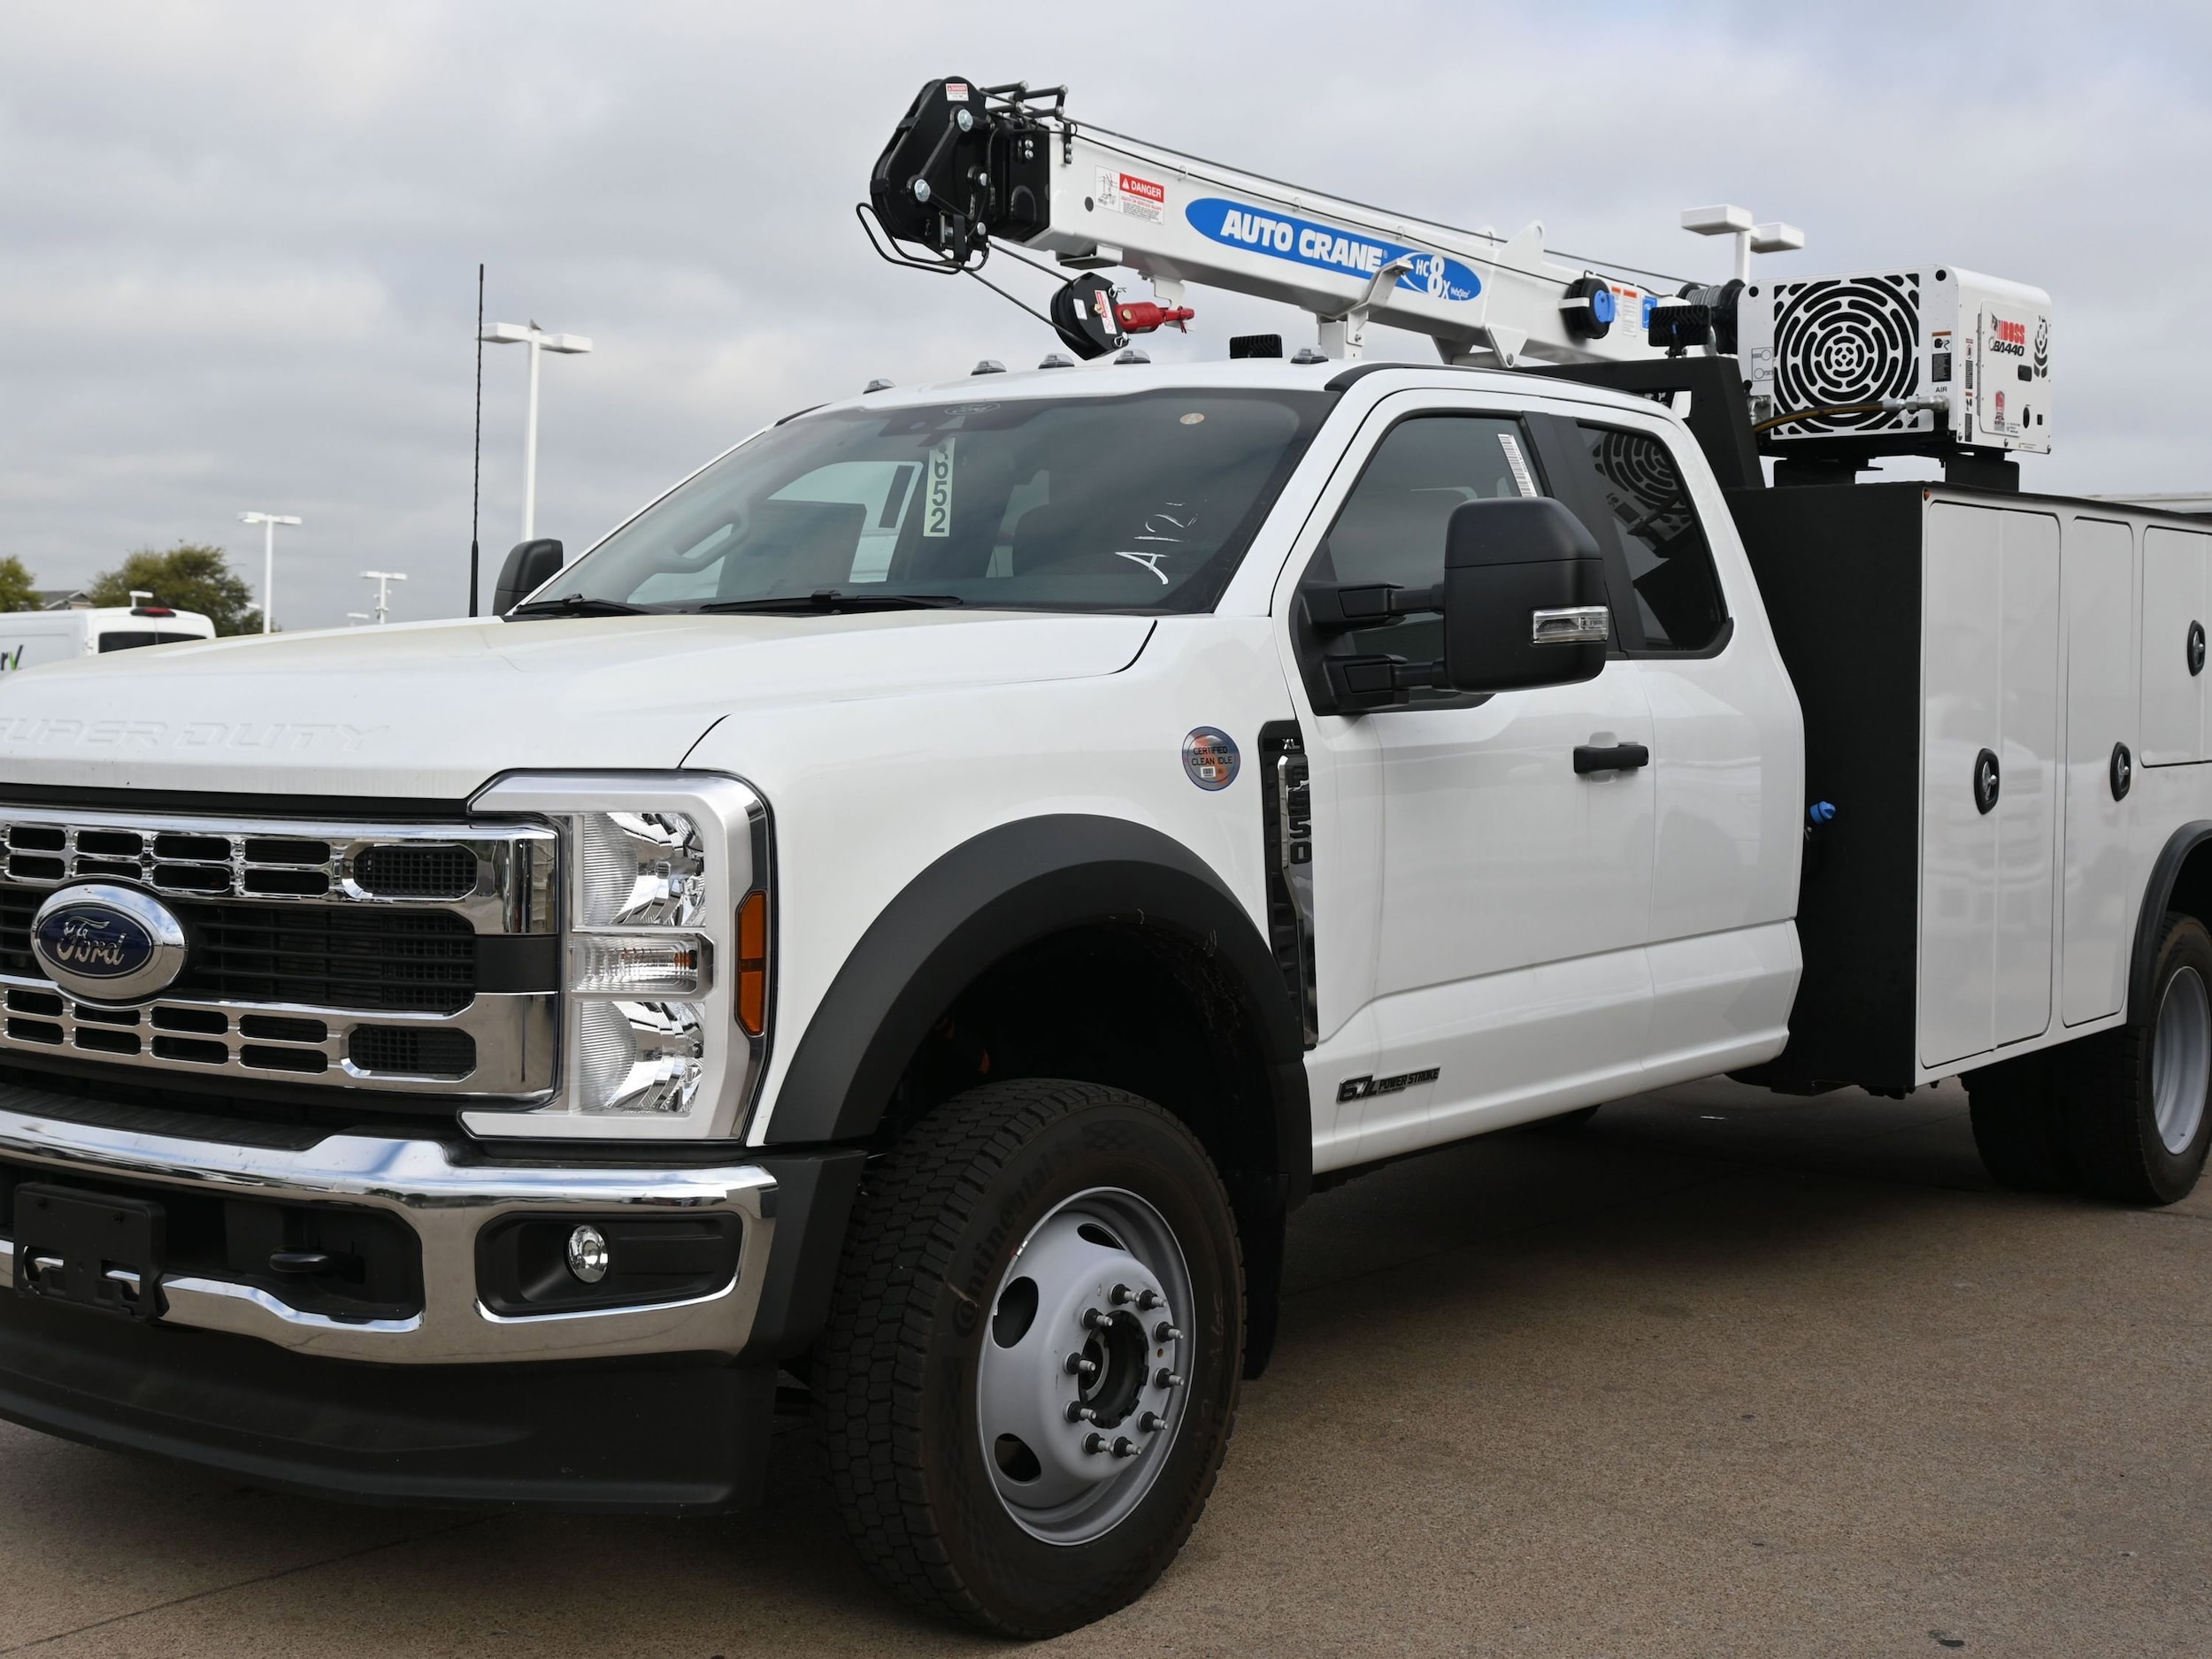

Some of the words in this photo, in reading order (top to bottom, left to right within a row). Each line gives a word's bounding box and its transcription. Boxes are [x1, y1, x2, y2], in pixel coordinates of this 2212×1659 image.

[1131, 180, 1162, 199] DANGER
[1220, 209, 1294, 252] AUTO
[1299, 228, 1383, 271] CRANE
[177, 721, 389, 750] DUTY
[1282, 739, 1301, 749] XL
[1191, 757, 1215, 766] CLEAN
[1217, 756, 1233, 764] IDLE
[1193, 746, 1228, 755] CERTIFIED
[57, 916, 127, 965] Ford
[1379, 1076, 1407, 1091] POWER
[1408, 1067, 1440, 1085] STROKE
